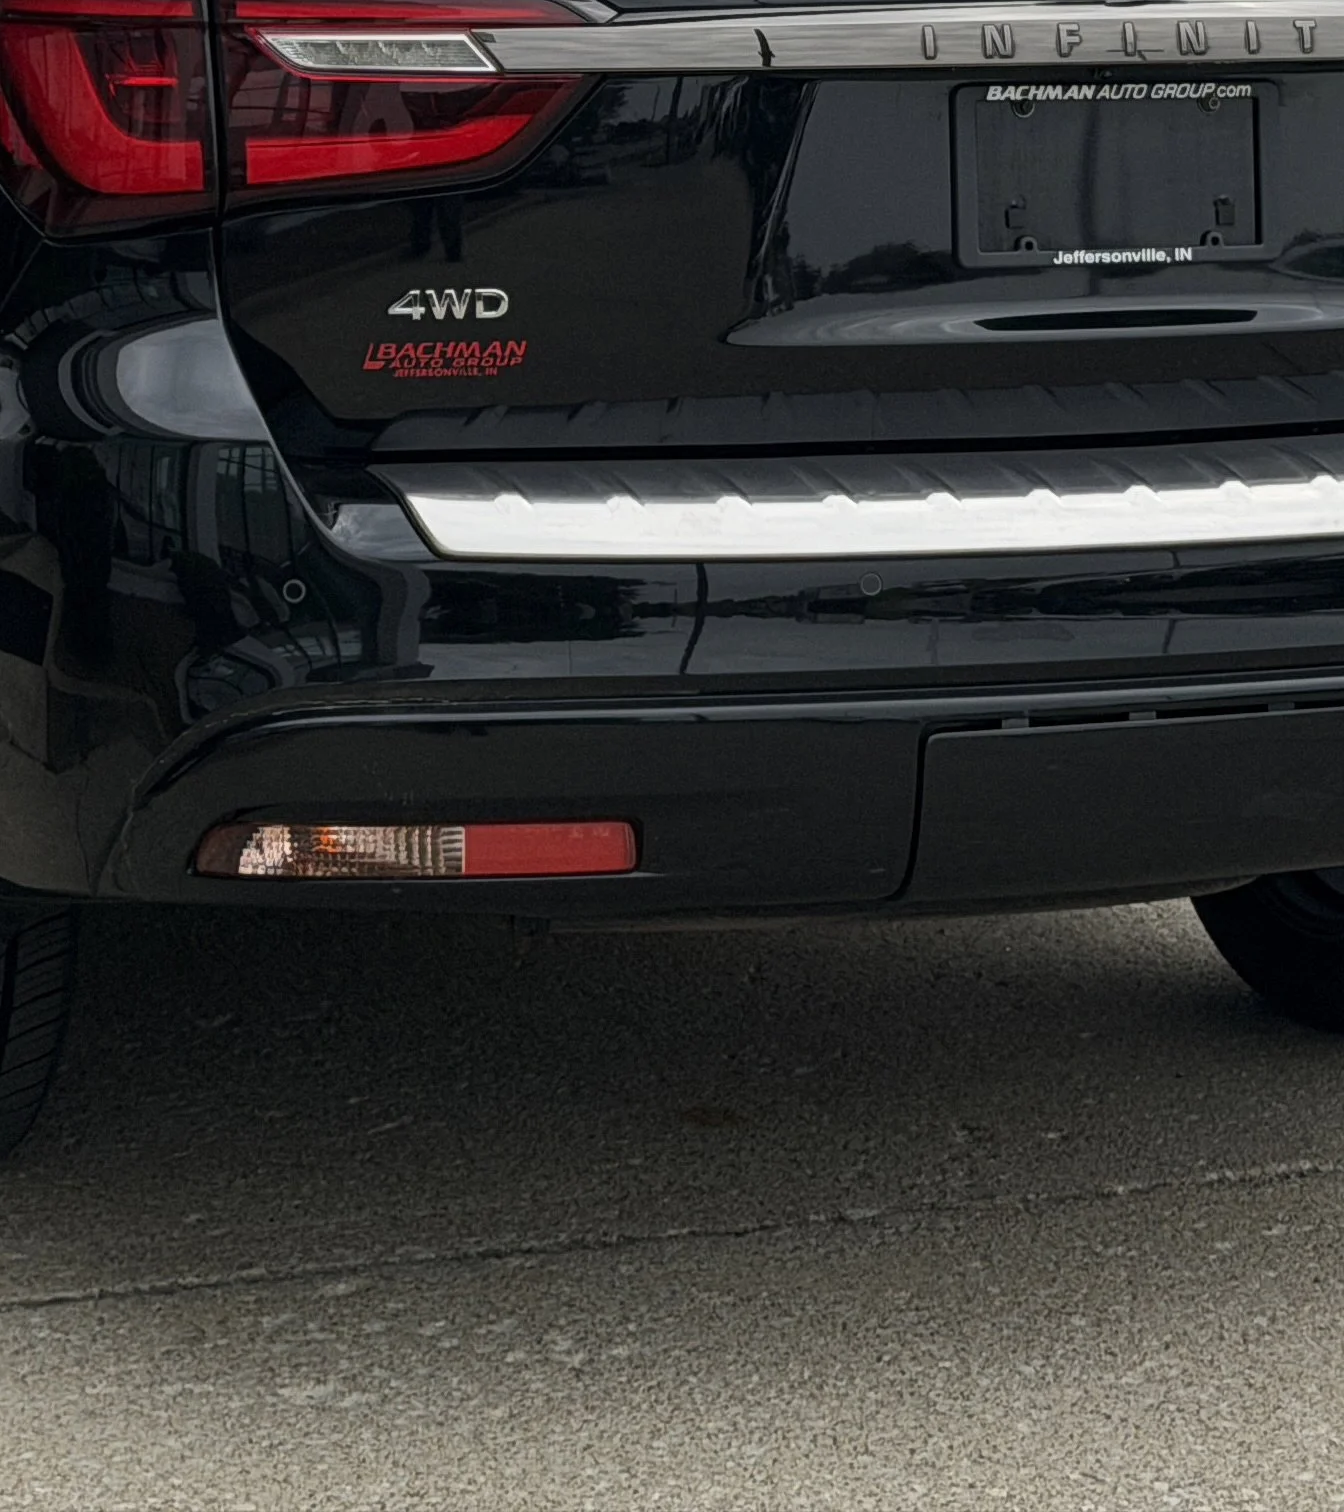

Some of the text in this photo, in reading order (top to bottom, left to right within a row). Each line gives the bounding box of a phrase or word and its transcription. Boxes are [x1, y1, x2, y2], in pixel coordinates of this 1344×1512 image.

[985, 82, 1252, 101] BACHMAN AUTO GROUP.com
[1053, 246, 1193, 265] Jeffersonville, IN
[387, 288, 509, 321] 4WD
[377, 340, 528, 360] BACHMAN
[388, 356, 524, 369] AUTO GROUP
[485, 366, 498, 377] IN
